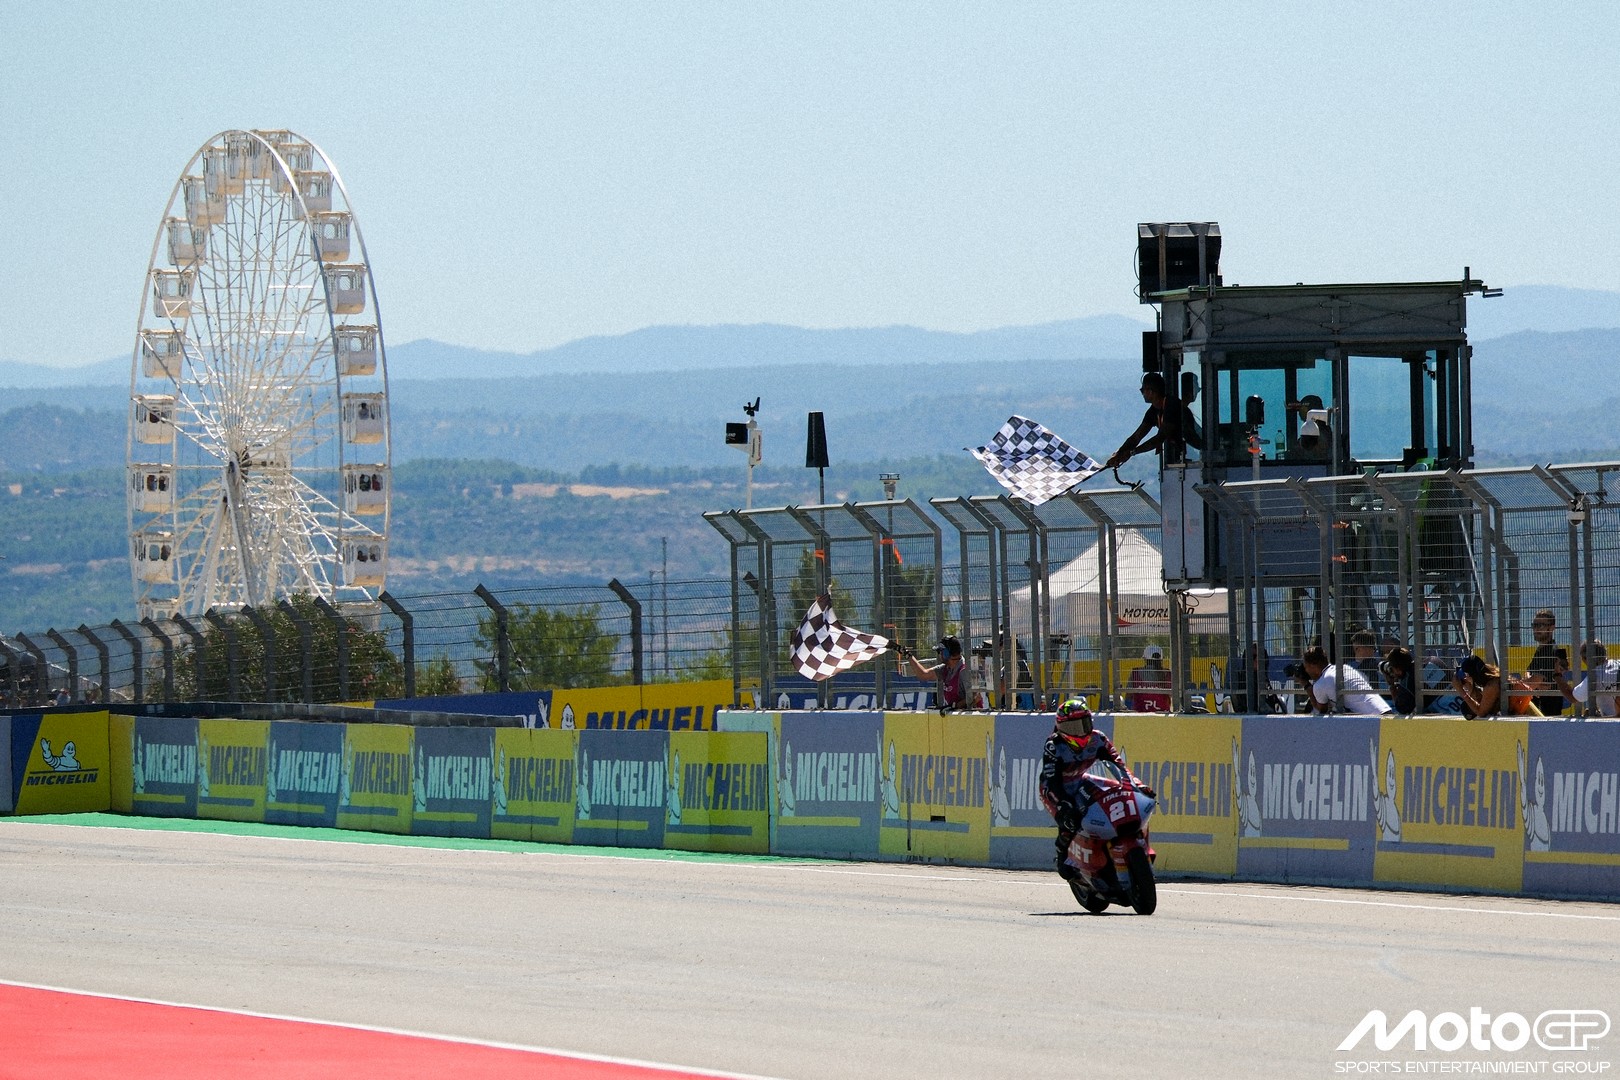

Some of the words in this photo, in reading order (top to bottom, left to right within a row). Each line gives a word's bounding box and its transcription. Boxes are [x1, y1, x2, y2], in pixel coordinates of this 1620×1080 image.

[25, 772, 98, 786] MICHELIN
[145, 743, 196, 784] MICHELIN
[210, 745, 265, 786] MICHELIN
[277, 750, 341, 794] MICHELIN
[352, 751, 410, 796] MICHELIN
[426, 755, 491, 800] MICHELIN
[507, 757, 574, 803] MICHELIN
[591, 760, 664, 807] MICHELIN
[795, 752, 877, 802] MICHELIN
[900, 754, 986, 808] MICHELIN
[683, 763, 767, 811] MICHELIN
[1263, 762, 1369, 822] MICHELIN
[1402, 766, 1517, 829] MICHELIN
[1551, 771, 1620, 834] MICH
[1109, 799, 1137, 823] 21
